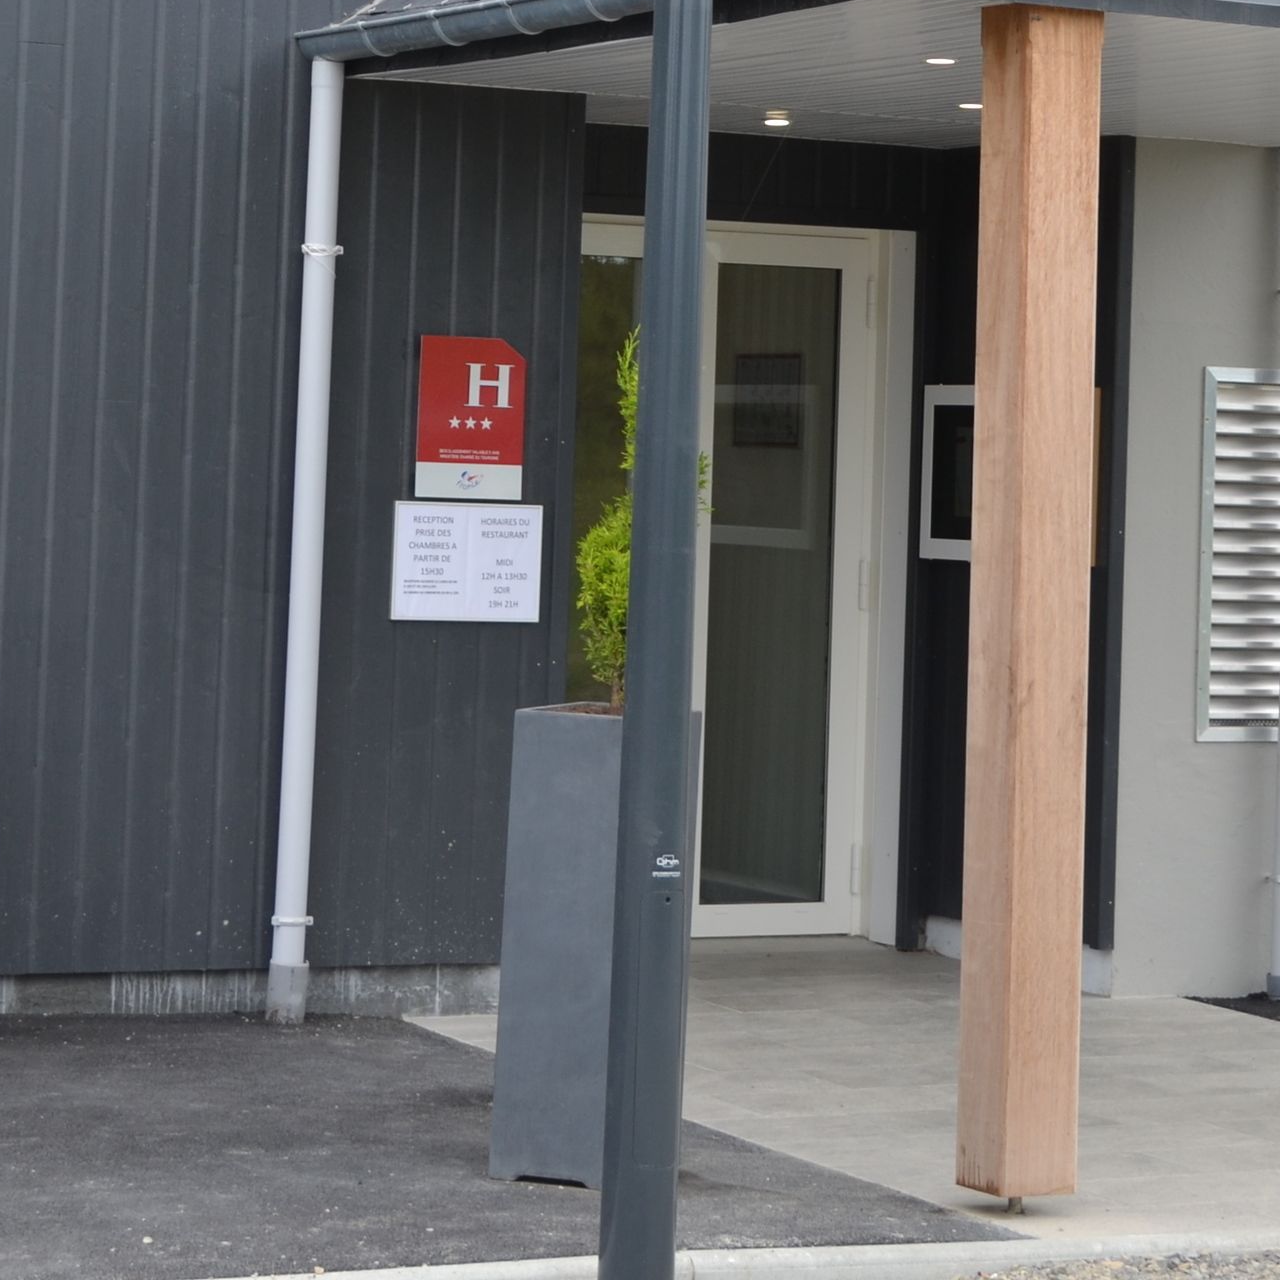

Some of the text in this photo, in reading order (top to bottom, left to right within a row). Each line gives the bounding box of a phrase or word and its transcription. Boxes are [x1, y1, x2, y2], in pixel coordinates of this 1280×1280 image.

[464, 363, 515, 408] H
[413, 516, 454, 524] RECEPTION
[481, 518, 517, 526] HORAIRES
[482, 531, 528, 539] RESTAURANT
[409, 541, 457, 550] CHAMBRES A
[494, 586, 510, 594] SOIR
